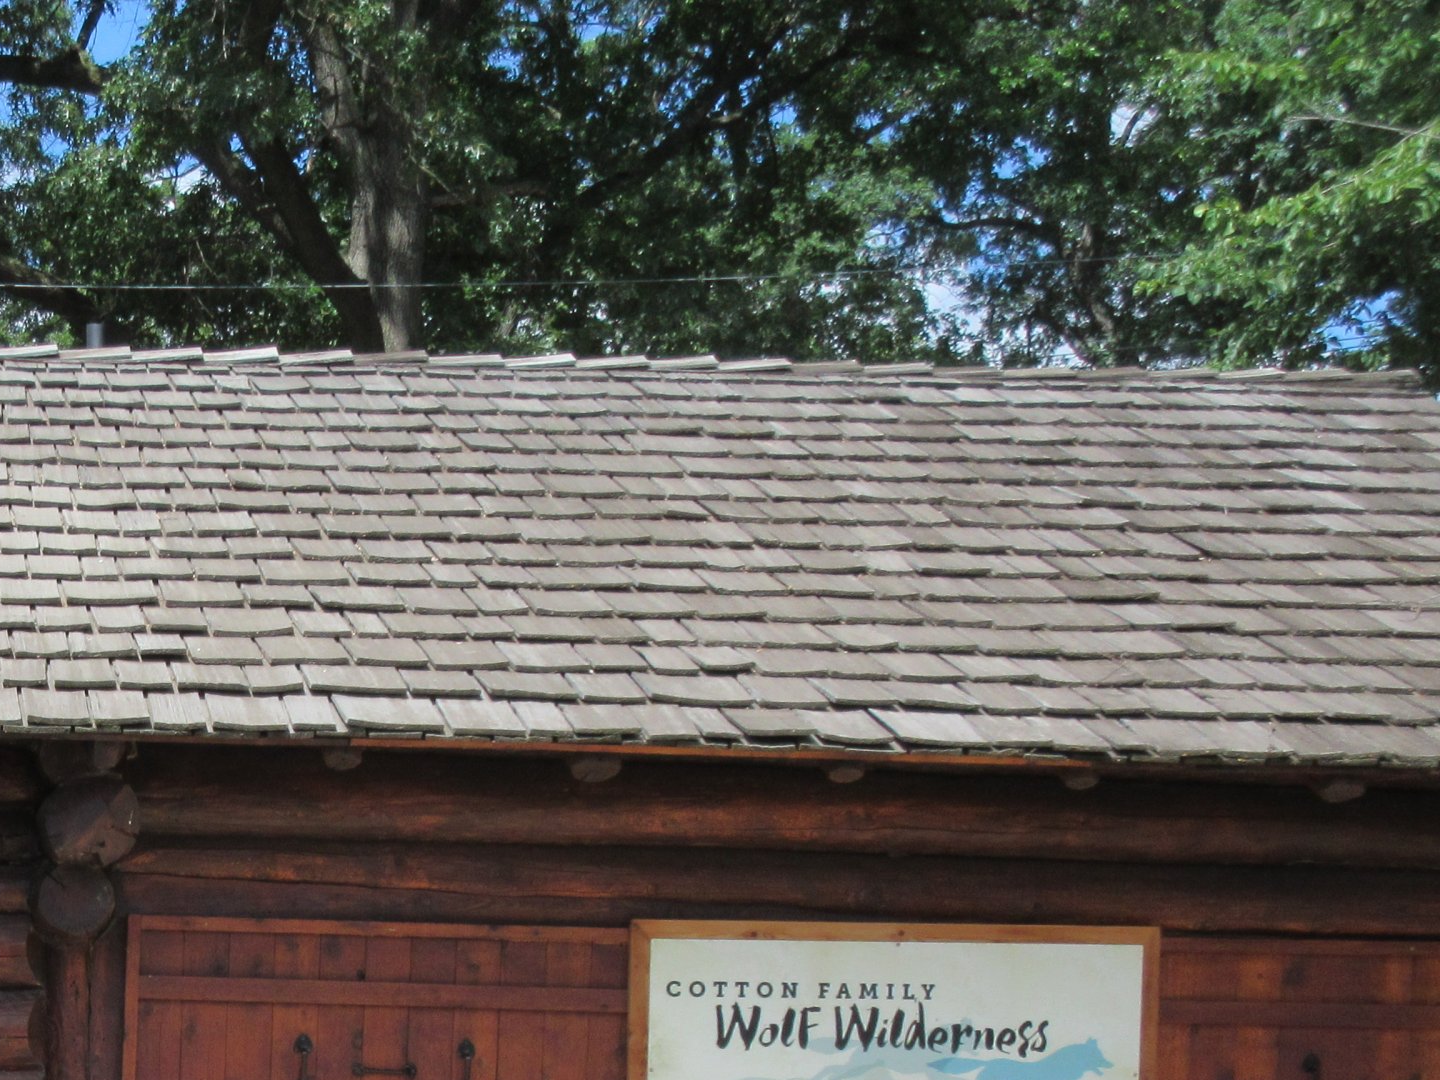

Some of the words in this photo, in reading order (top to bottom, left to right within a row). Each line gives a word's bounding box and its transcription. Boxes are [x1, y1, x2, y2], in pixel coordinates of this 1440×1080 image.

[666, 980, 799, 998] COTTON
[818, 982, 936, 1001] FAMILY
[834, 1000, 1049, 1058] Wilderness
